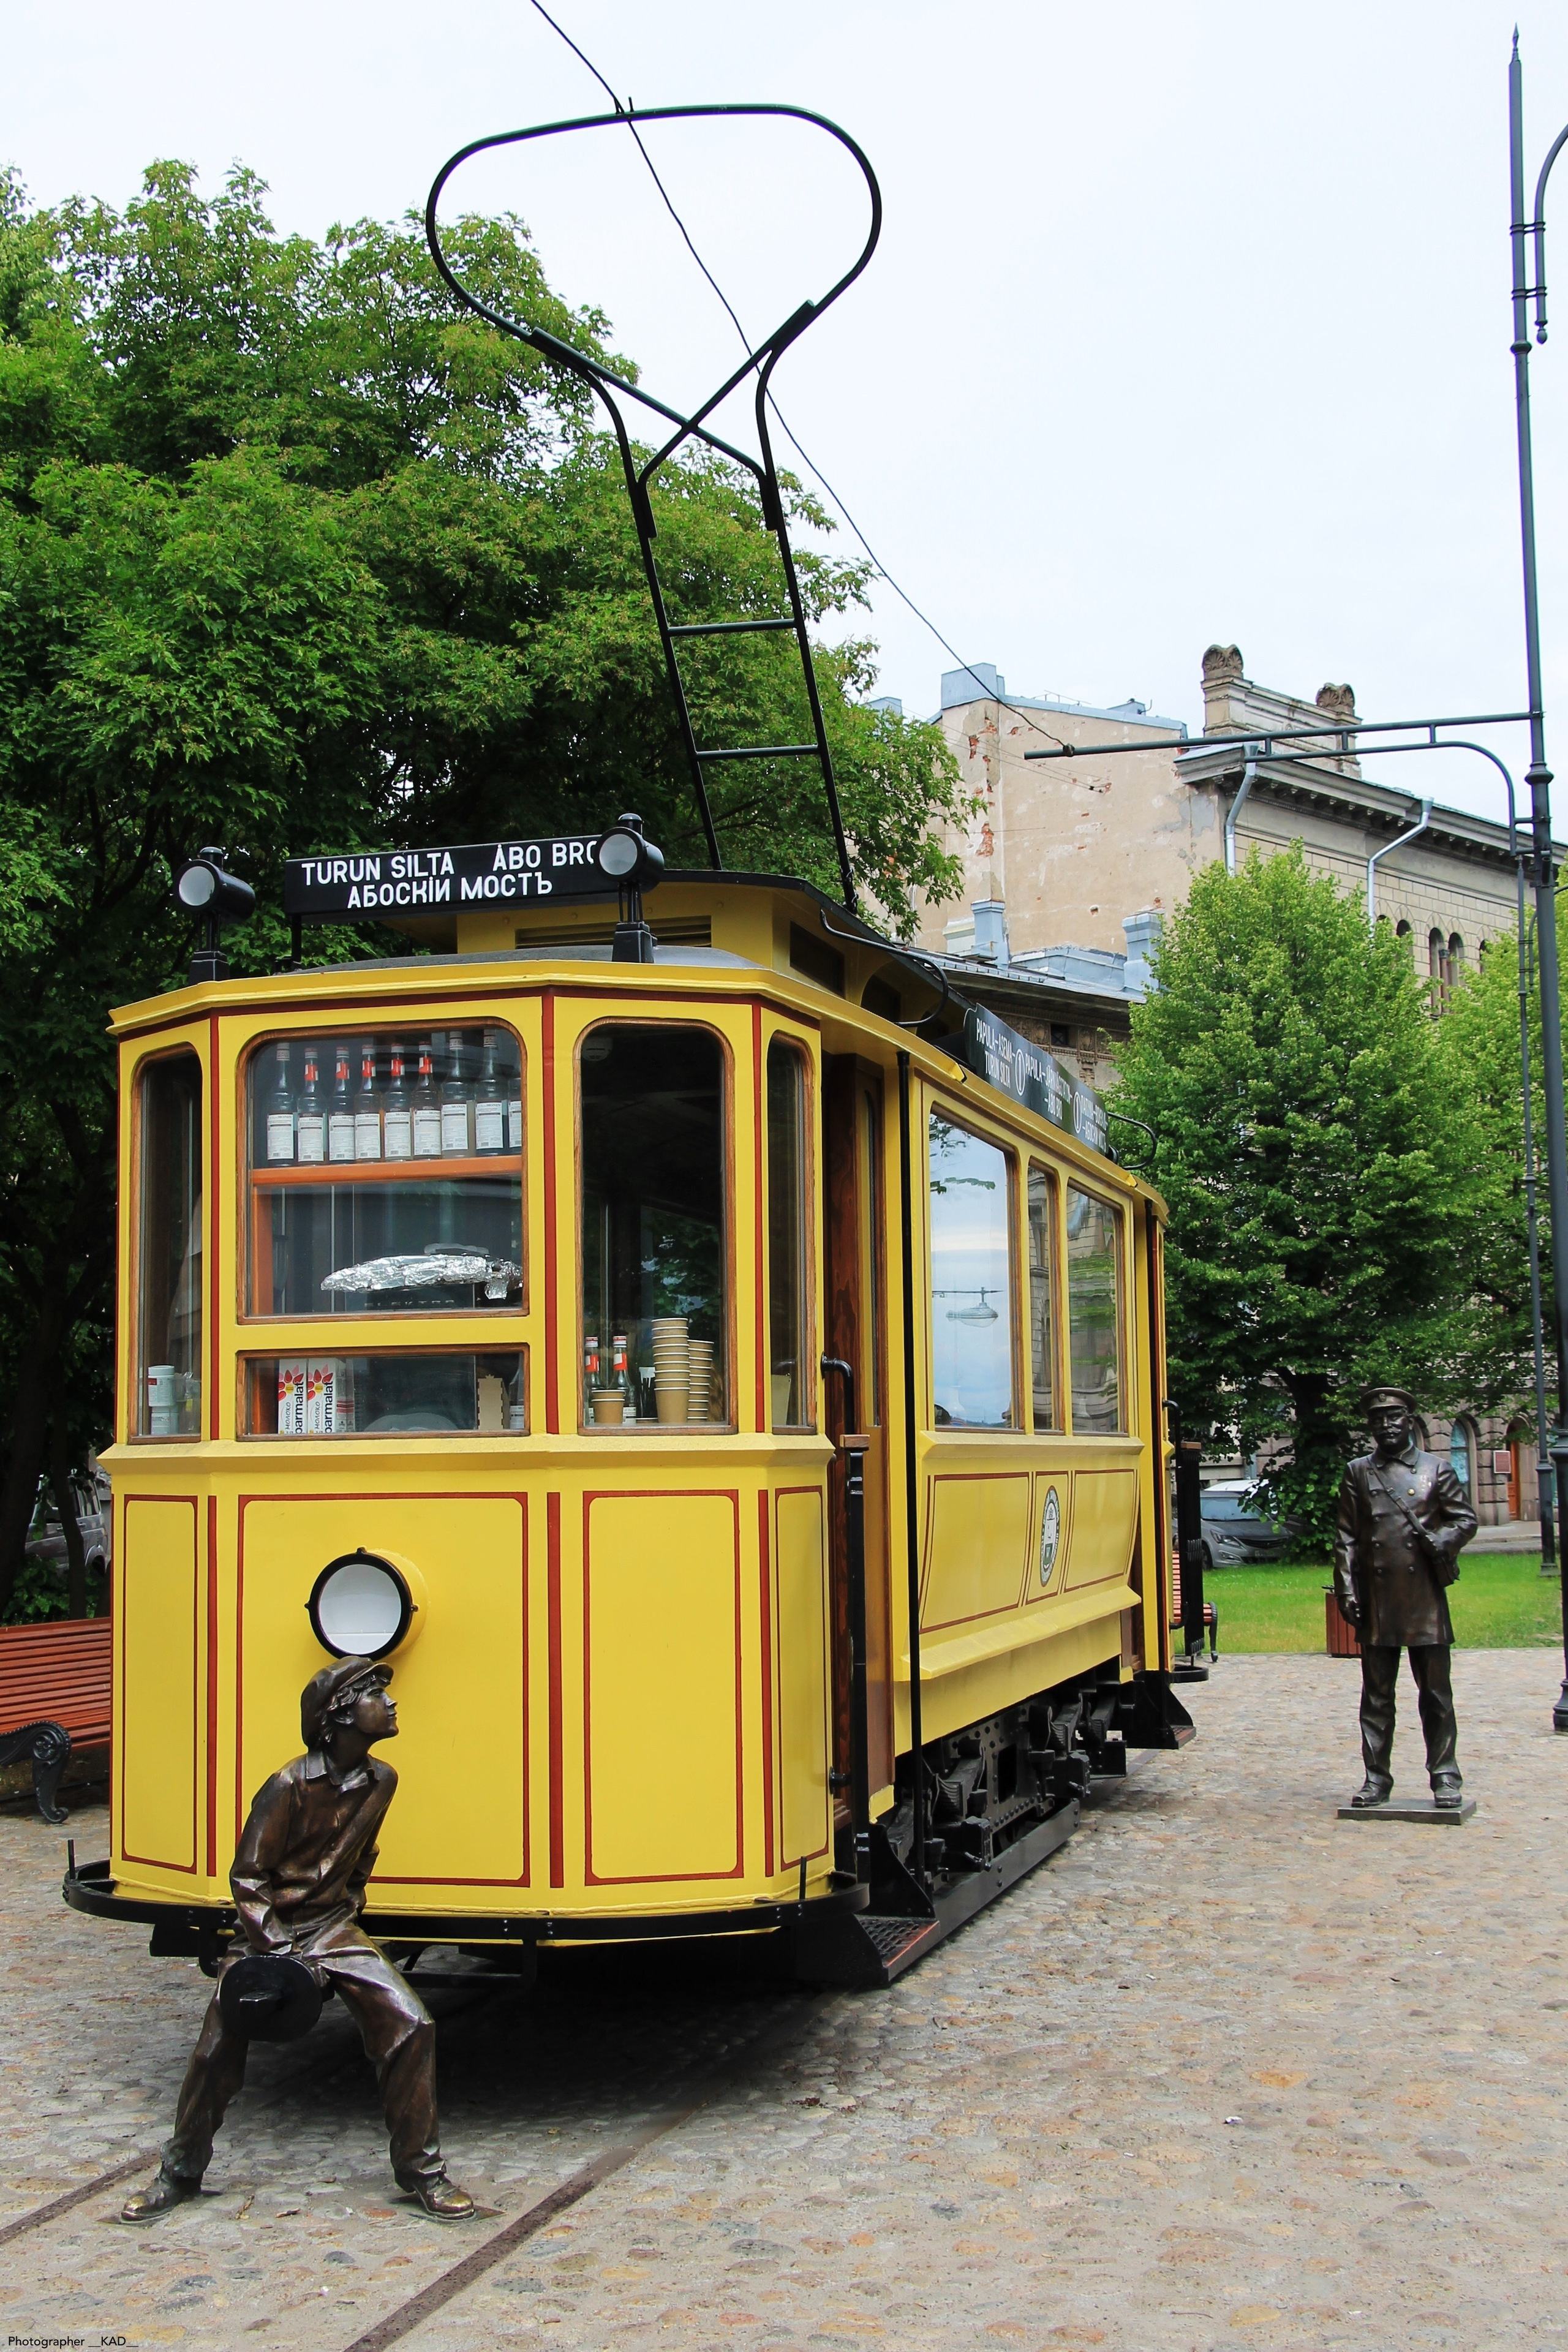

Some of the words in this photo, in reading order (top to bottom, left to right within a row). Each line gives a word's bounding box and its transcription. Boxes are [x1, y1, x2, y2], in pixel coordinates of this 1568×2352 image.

[301, 858, 380, 886] TURUN
[391, 852, 454, 878] SILTA
[492, 844, 541, 871] ÅBO
[461, 872, 552, 900] МОСТЪ
